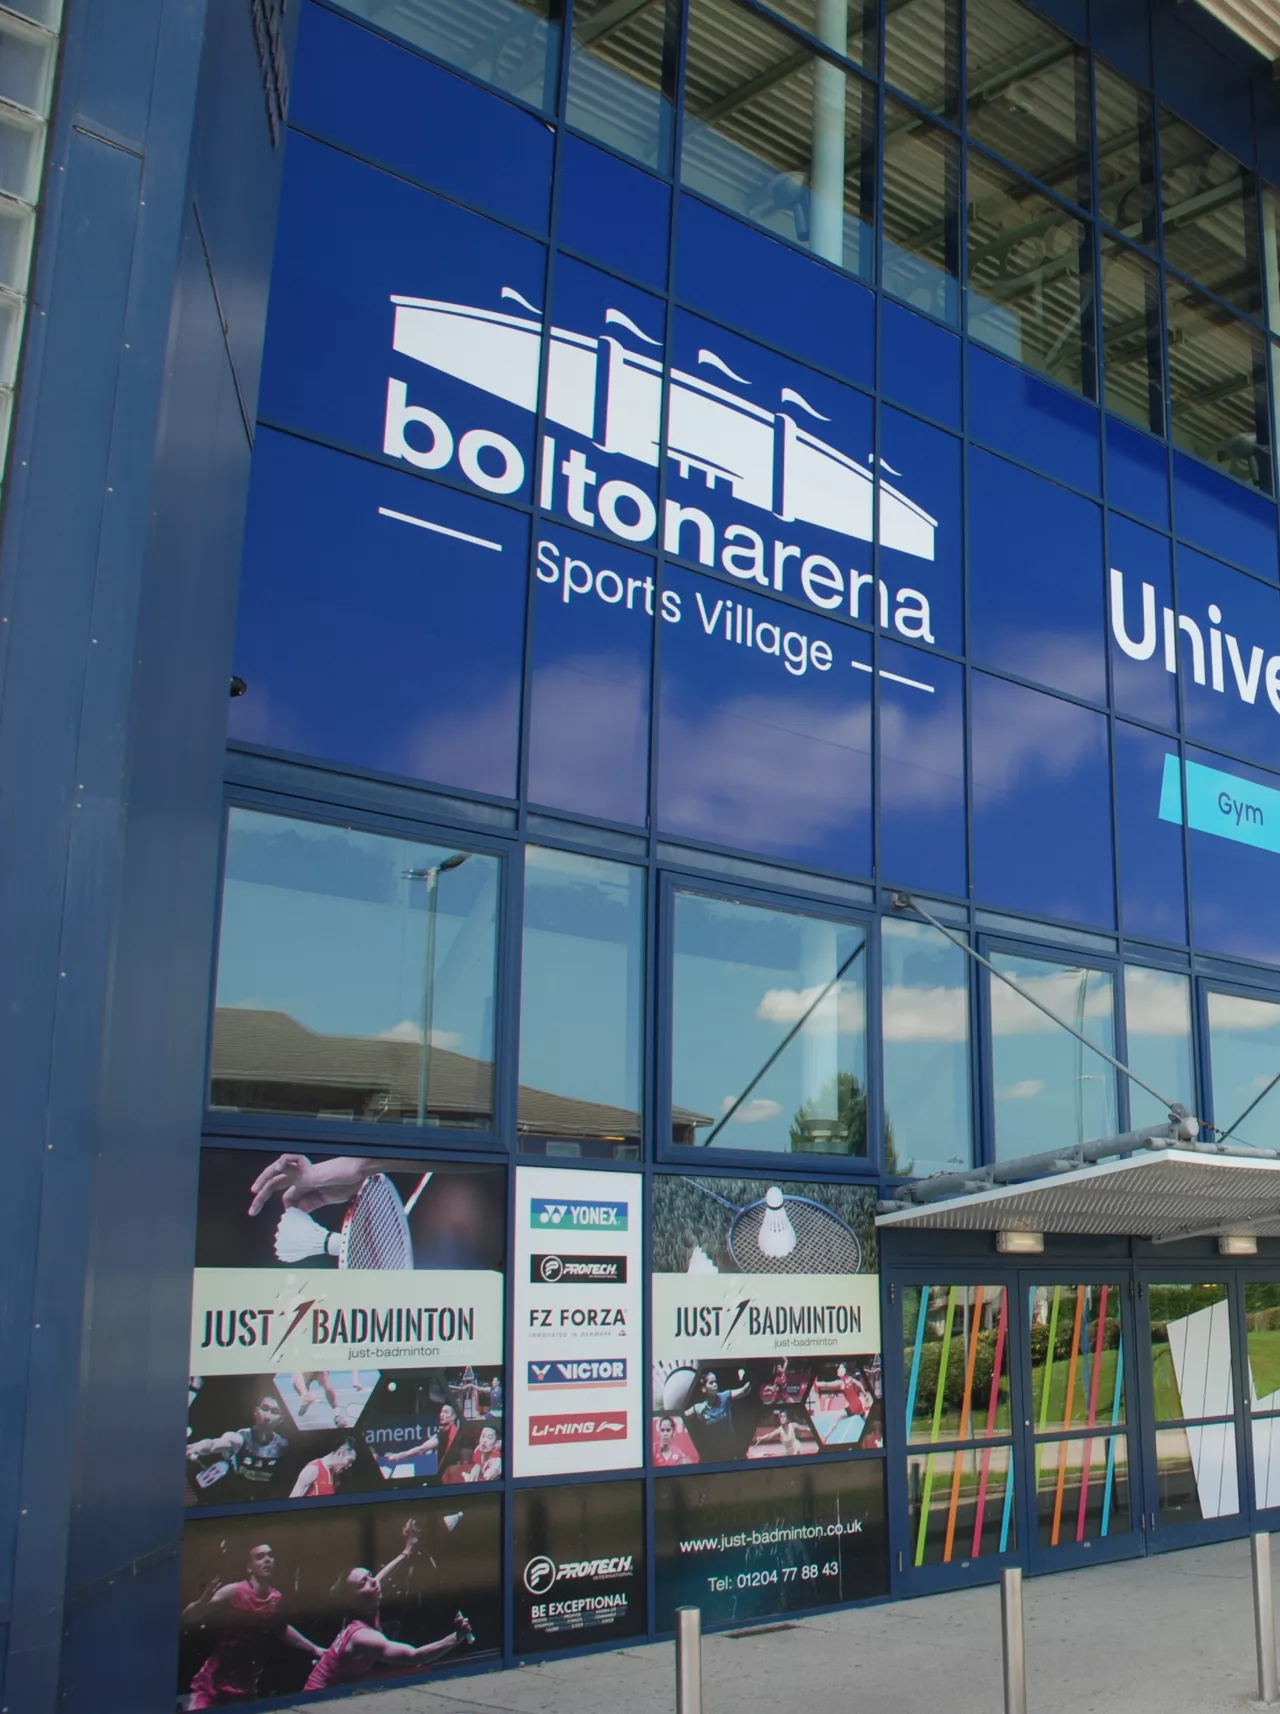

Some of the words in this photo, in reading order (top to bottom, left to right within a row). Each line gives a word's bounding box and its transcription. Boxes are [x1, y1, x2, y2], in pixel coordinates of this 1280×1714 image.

[383, 377, 935, 645] boltonarena
[536, 540, 682, 624] Sports
[695, 591, 833, 676] Village
[1217, 792, 1264, 826] Gym
[570, 1206, 618, 1225] YONEX
[201, 1309, 275, 1348] JUST
[311, 1307, 475, 1345] BADMINTON
[529, 1309, 553, 1327] FZ
[560, 1308, 626, 1327] FORZA
[675, 1306, 723, 1338] JUST
[749, 1305, 862, 1336] BADMINTON
[347, 1345, 440, 1361] just-badminton
[774, 1336, 838, 1349] just-badminton
[556, 1362, 624, 1380] VICTOR
[531, 1420, 596, 1437] LI-NING
[680, 1518, 863, 1553] www.just-badminton.co.uk
[708, 1576, 733, 1592] Tel:
[737, 1569, 779, 1589] 01204
[781, 1567, 798, 1583] 77
[801, 1564, 819, 1580] 88
[821, 1561, 839, 1577] 43
[531, 1604, 547, 1619] BE
[548, 1592, 628, 1616] EXCEPTIONAL
